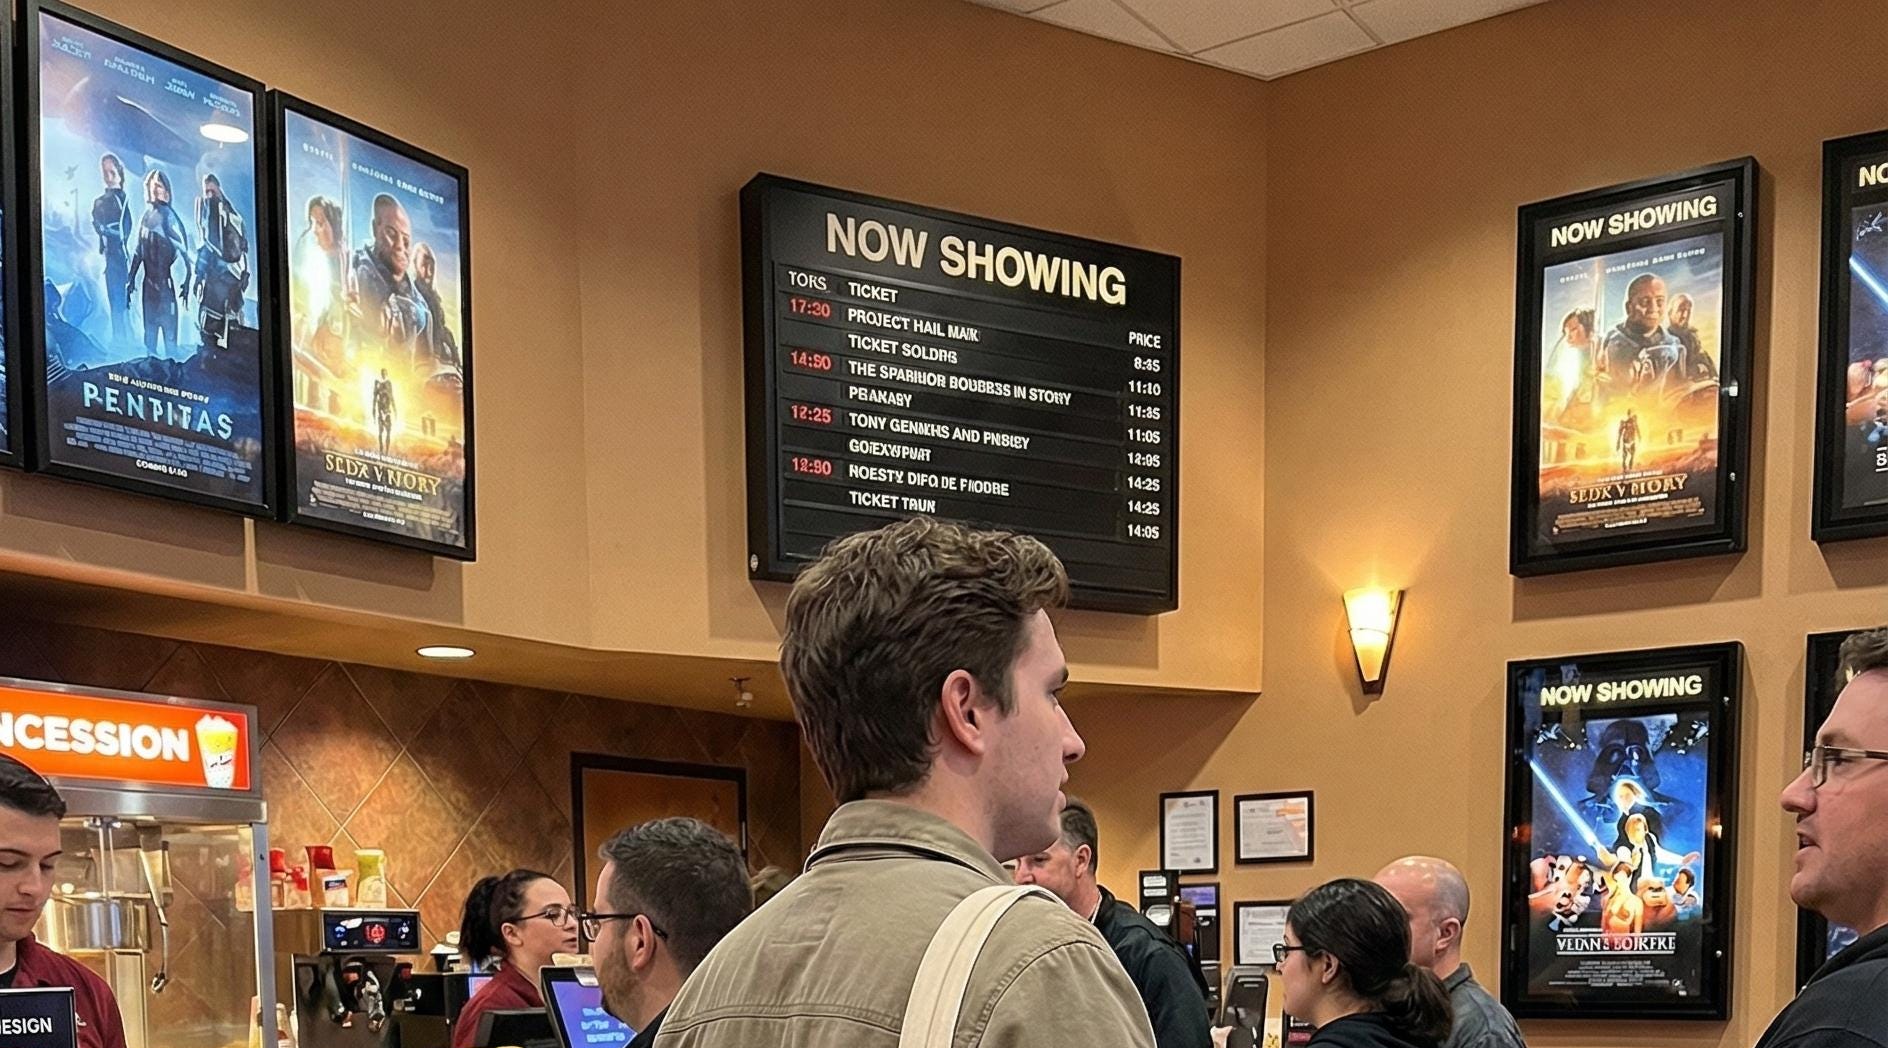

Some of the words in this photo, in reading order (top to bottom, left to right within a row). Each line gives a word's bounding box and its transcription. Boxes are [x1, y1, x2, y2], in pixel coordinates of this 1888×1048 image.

[1551, 217, 1604, 247] NOW
[1608, 195, 1717, 236] SHOWING
[826, 212, 928, 269] NOW
[939, 235, 1126, 306] SHOWING
[848, 281, 898, 303] TICKET
[848, 307, 911, 331] PROJECT
[913, 319, 945, 338] HAIL
[848, 334, 899, 355] TICKET
[1128, 331, 1161, 349] PRICE
[848, 360, 877, 377] THE
[1013, 385, 1027, 400] IN
[848, 412, 887, 430] TONY
[951, 426, 981, 443] AND
[941, 477, 957, 491] DE
[849, 490, 900, 510] TICKET
[1540, 684, 1593, 706] NOW
[1596, 675, 1703, 703] SHOWING
[0, 1017, 53, 1035] ESIGN
